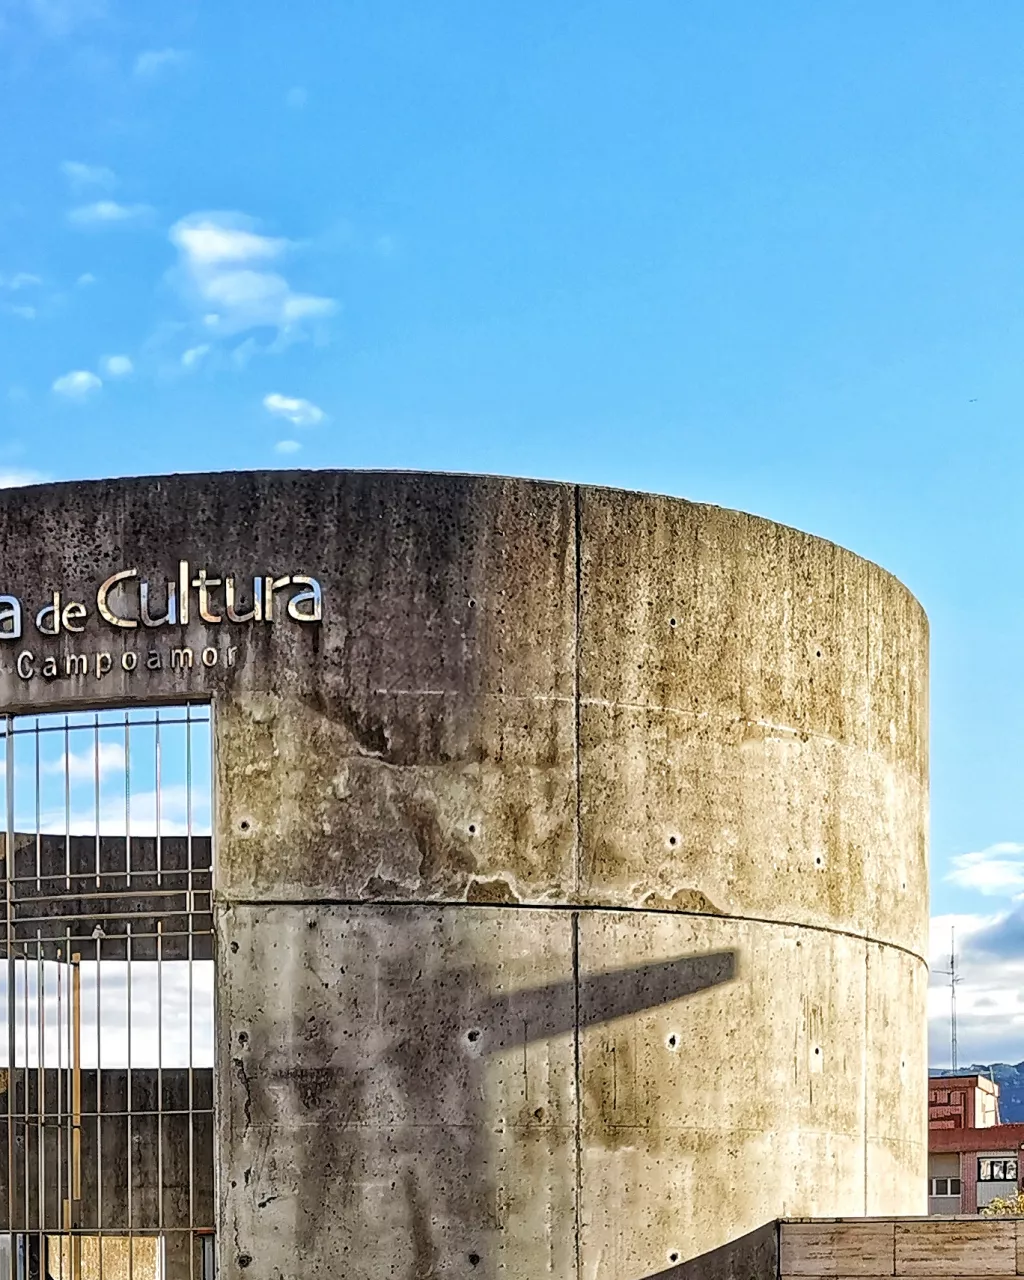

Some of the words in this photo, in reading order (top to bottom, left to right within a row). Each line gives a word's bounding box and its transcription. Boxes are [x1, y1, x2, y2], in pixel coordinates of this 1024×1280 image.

[35, 591, 87, 636] de
[96, 559, 324, 628] Cultura
[17, 642, 238, 680] Campoamor
